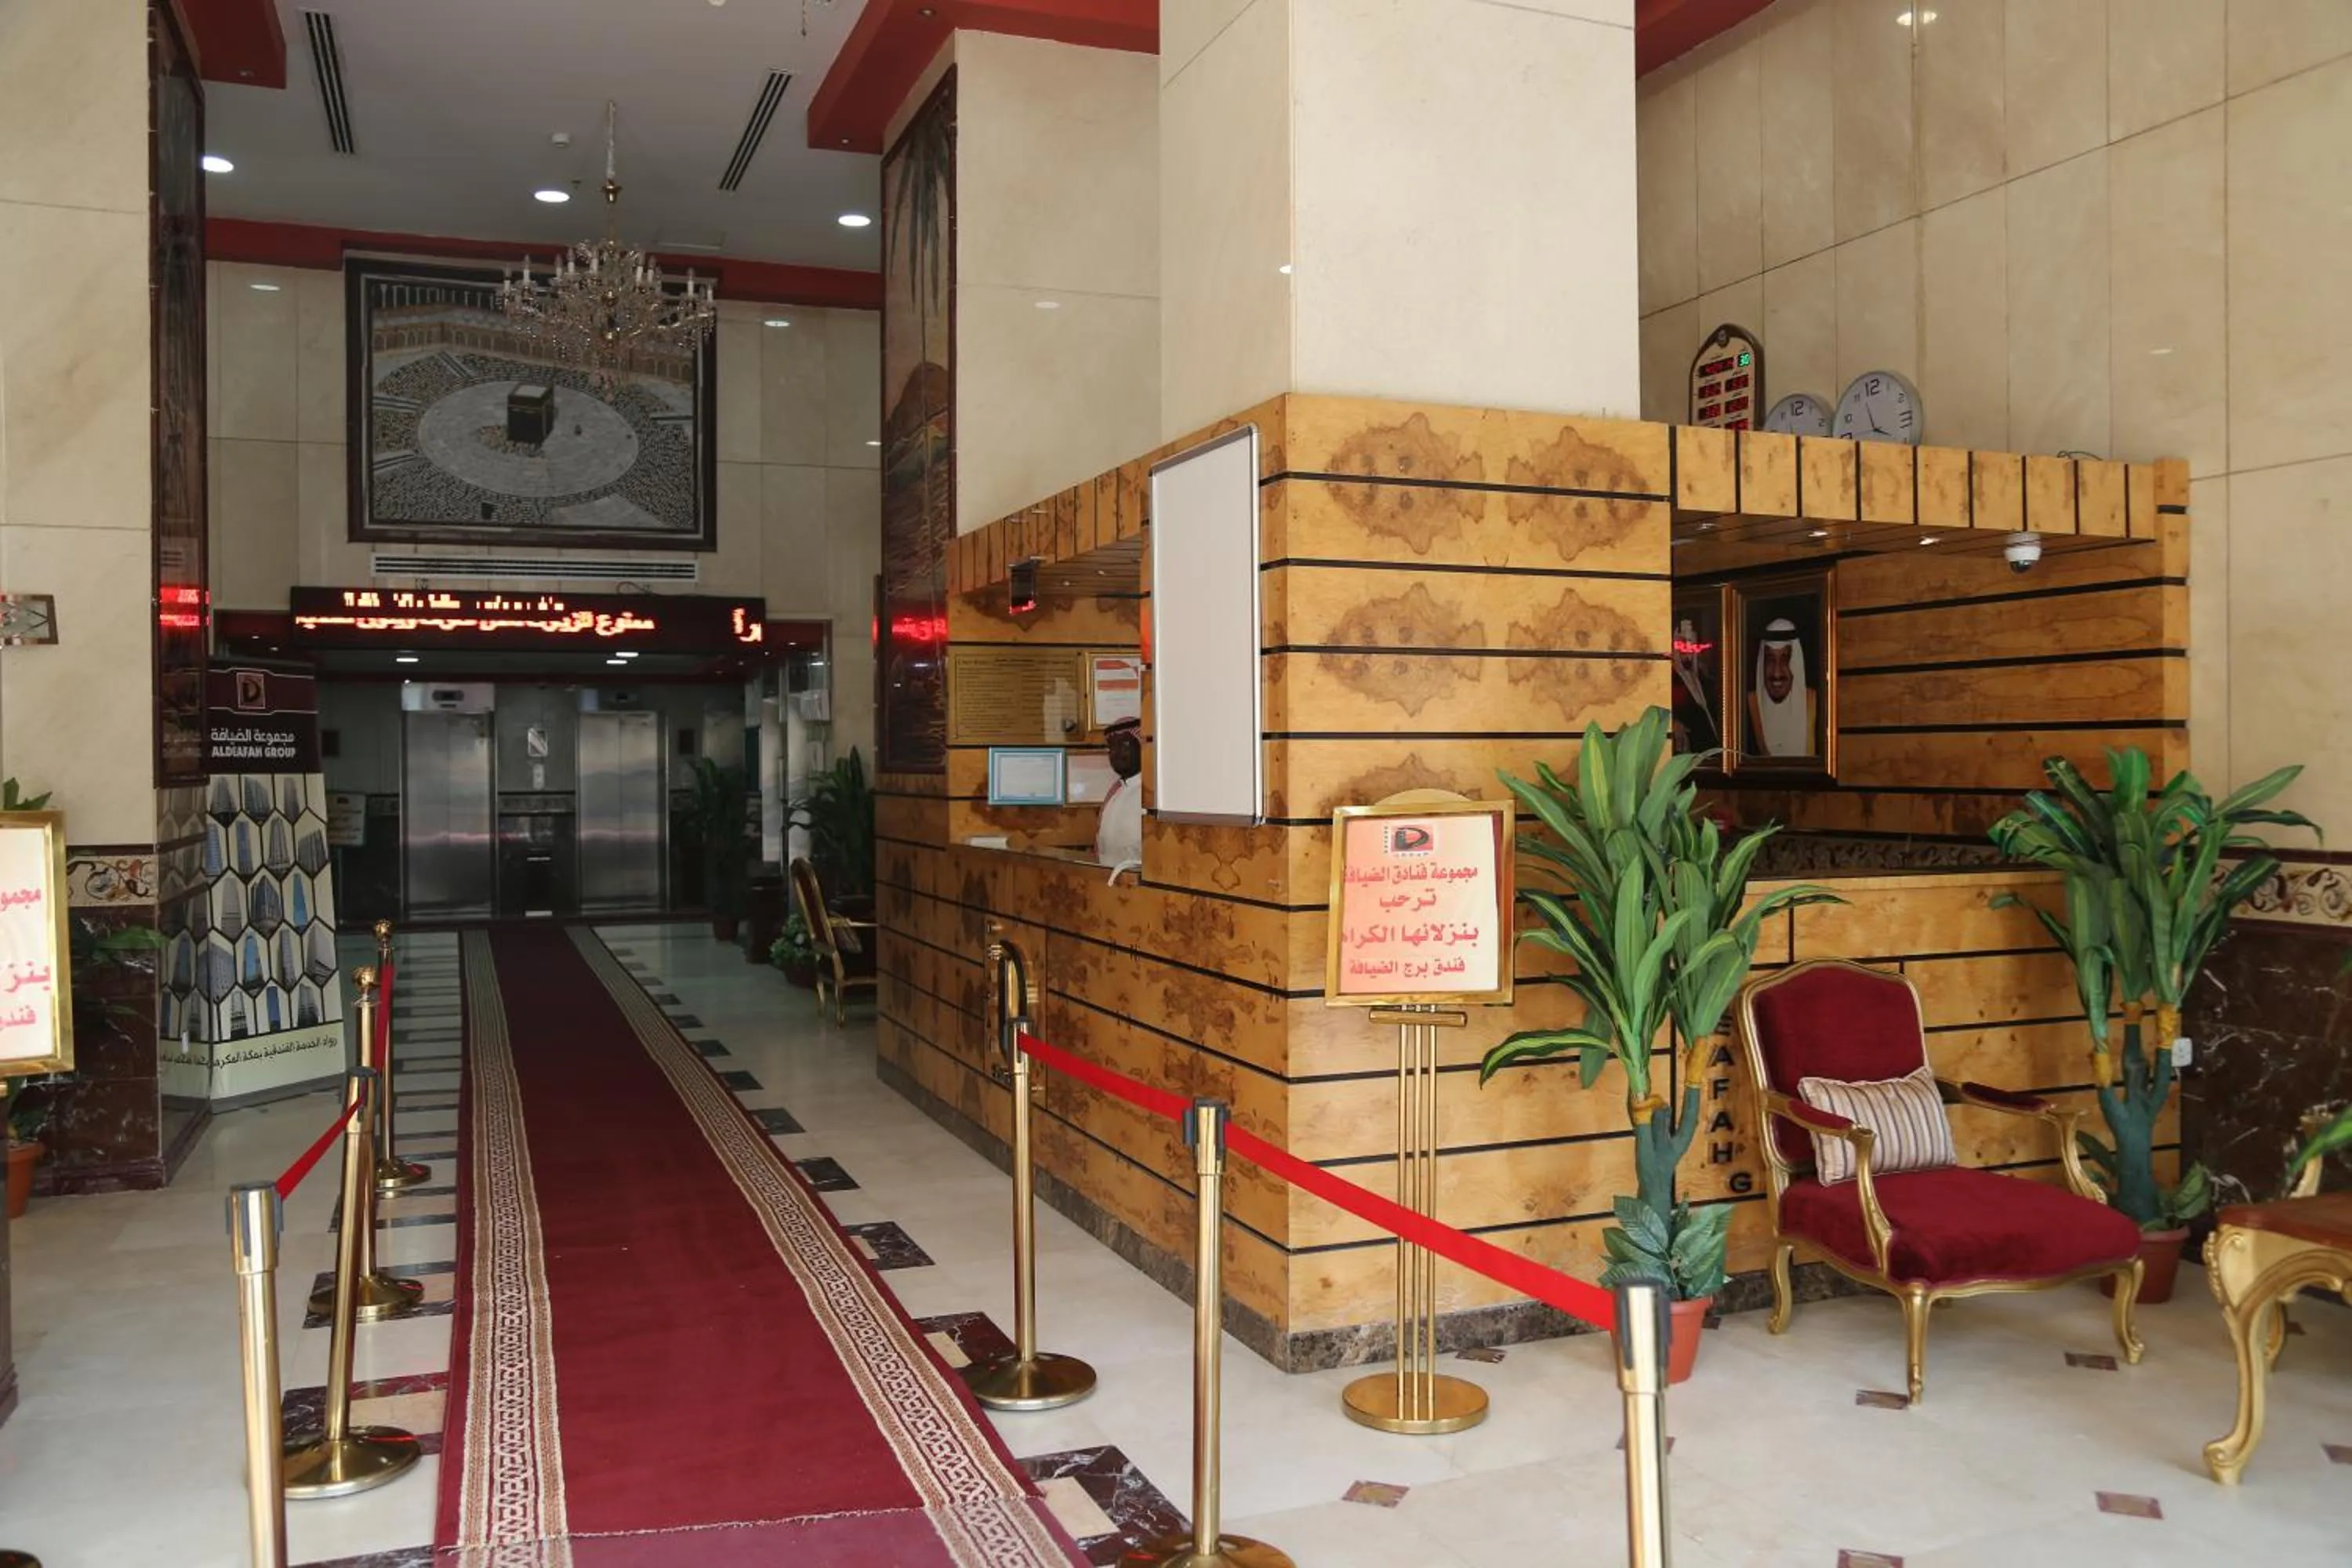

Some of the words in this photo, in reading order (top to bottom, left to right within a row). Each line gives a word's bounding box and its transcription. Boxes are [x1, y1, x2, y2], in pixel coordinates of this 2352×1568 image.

[1865, 378, 1881, 397] 12
[1790, 401, 1804, 416] 12
[264, 746, 296, 759] GROUP
[1344, 865, 1390, 887] الضياف
[1392, 863, 1428, 885] فنادق
[1432, 862, 1479, 884] مجموعة
[1379, 887, 1437, 913] ترحب
[1350, 959, 1399, 979] الضيافة
[1403, 961, 1428, 978] برج
[1432, 956, 1466, 976] فندق
[212, 1051, 241, 1069] المكرم
